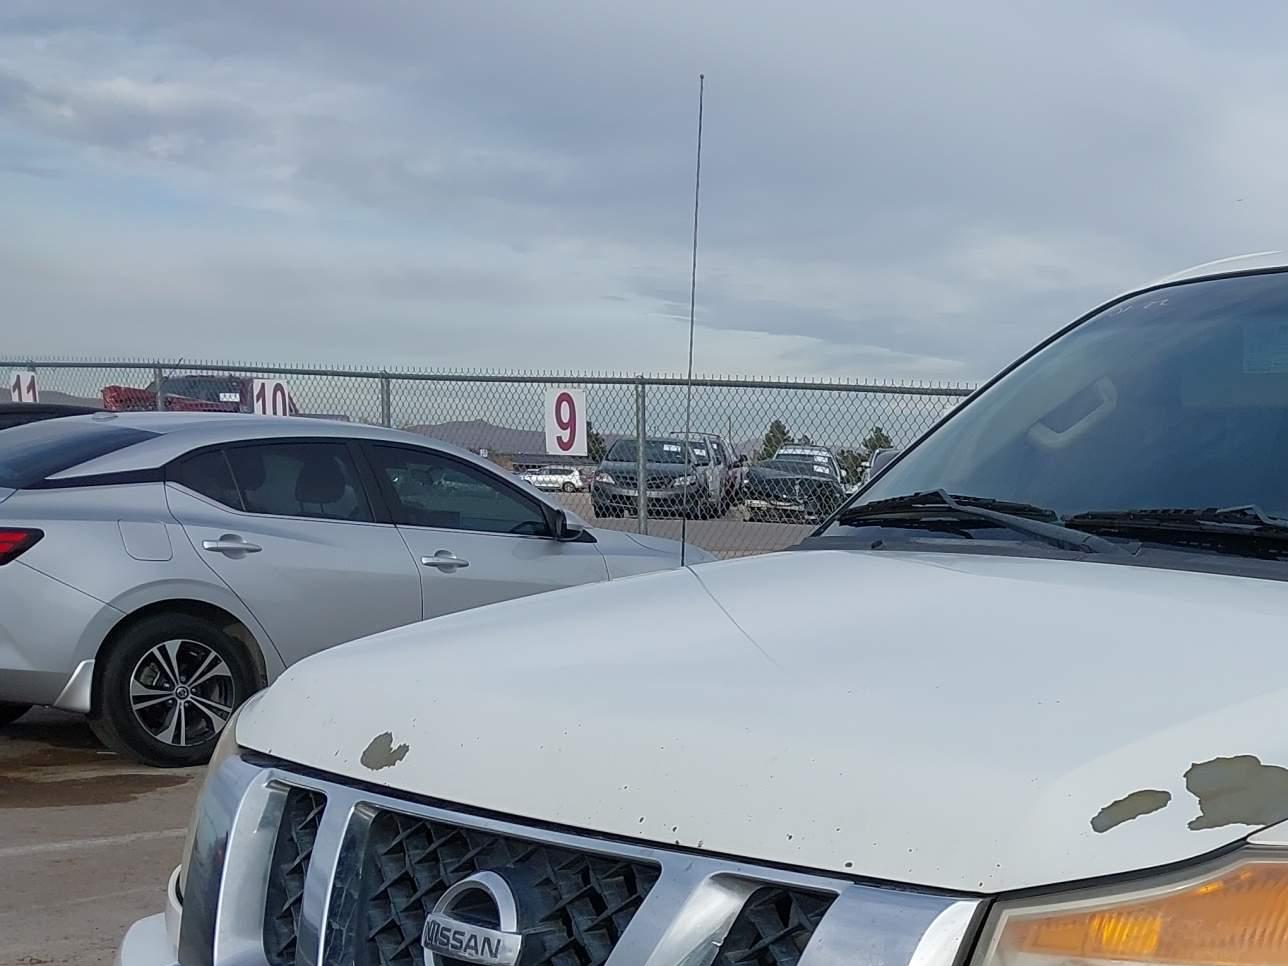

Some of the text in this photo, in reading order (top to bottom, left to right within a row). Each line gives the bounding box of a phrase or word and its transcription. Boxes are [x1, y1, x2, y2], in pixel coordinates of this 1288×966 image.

[11, 374, 40, 402] 11
[255, 382, 288, 416] 10
[554, 391, 578, 451] 9
[425, 919, 502, 960] NISSAN
